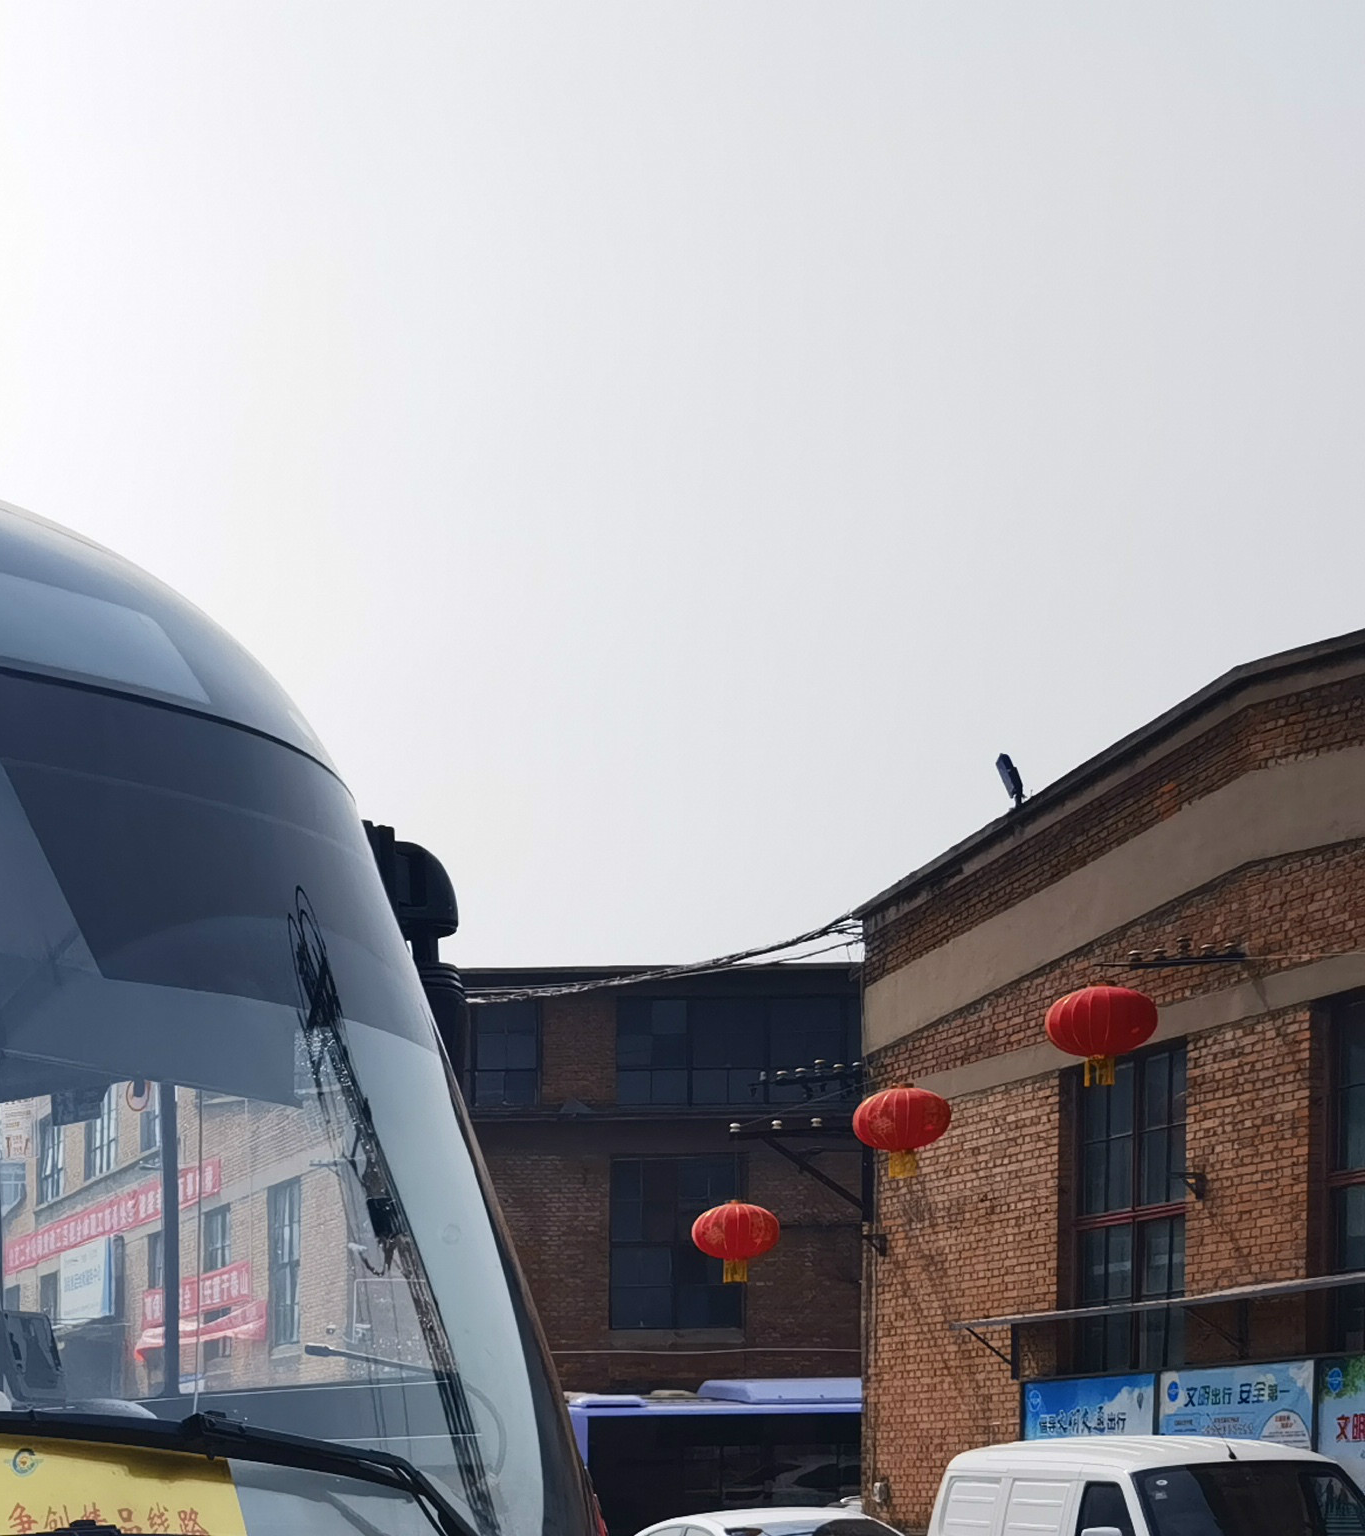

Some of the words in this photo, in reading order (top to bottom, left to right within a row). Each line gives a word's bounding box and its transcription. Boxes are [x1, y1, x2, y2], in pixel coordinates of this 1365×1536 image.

[1184, 1386, 1233, 1409] 文明出行
[1237, 1382, 1291, 1405] 安全第一
